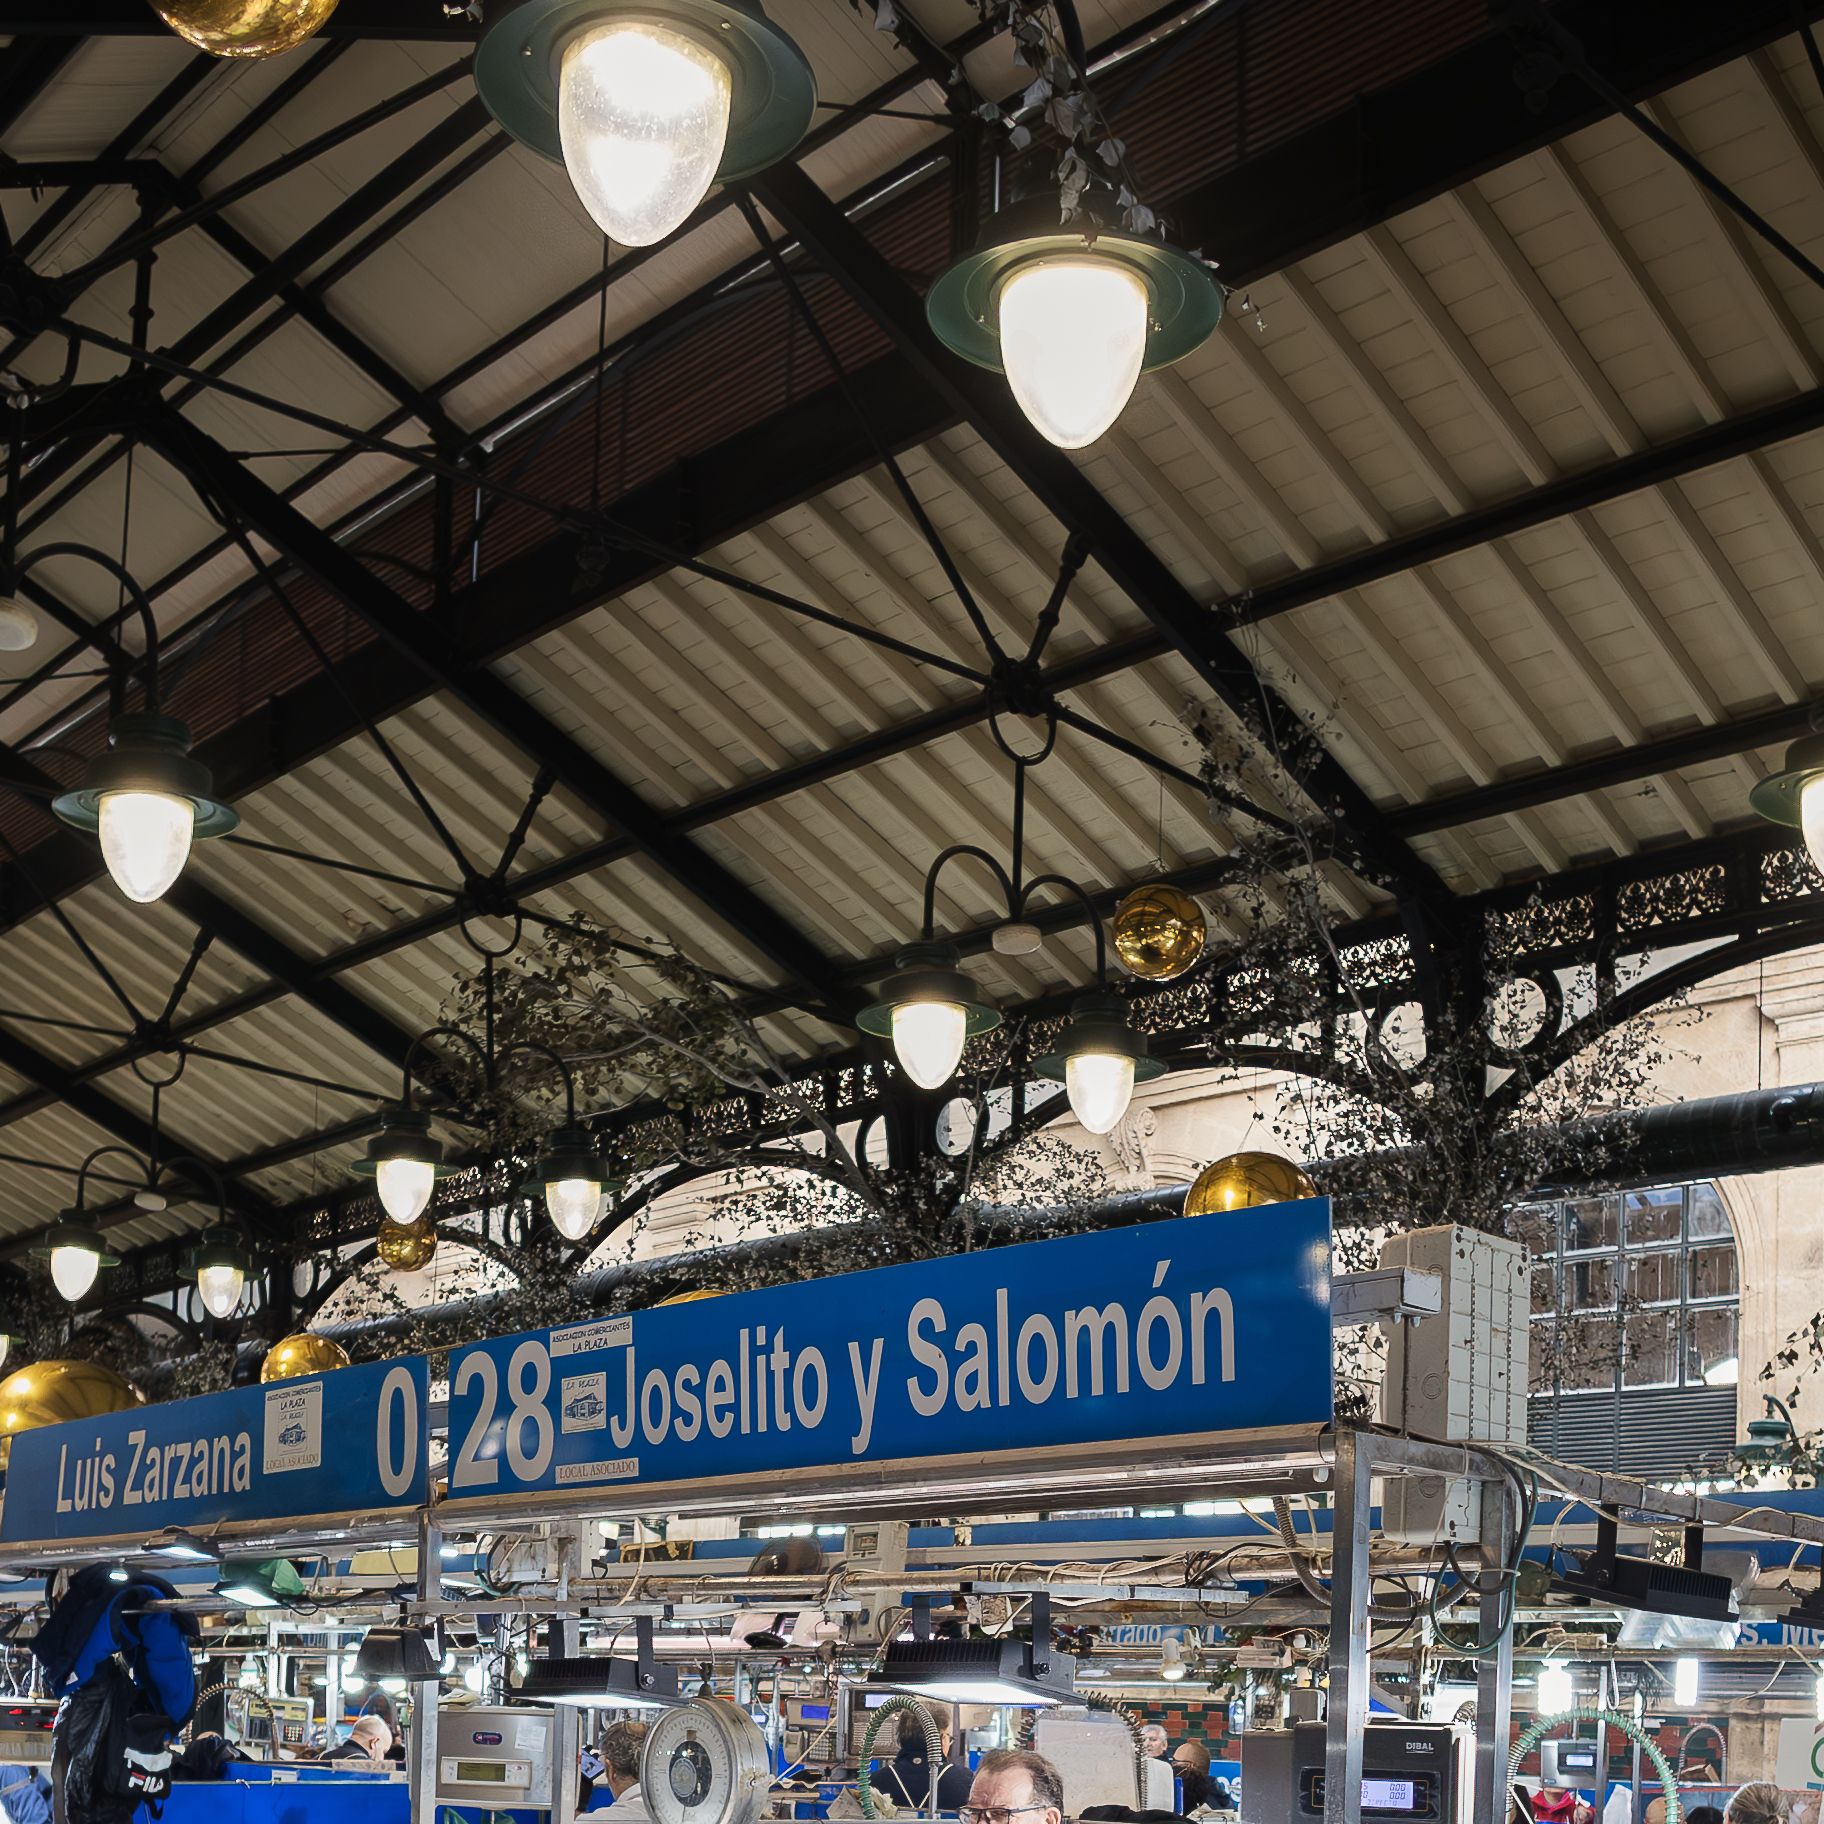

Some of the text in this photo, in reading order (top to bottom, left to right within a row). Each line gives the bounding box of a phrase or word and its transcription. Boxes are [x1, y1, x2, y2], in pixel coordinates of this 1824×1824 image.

[573, 1338, 608, 1353] LA PLAZA
[453, 1259, 1238, 1486] 28 Joselito y Salomón
[56, 1366, 418, 1513] Luis Zarzana 0
[559, 1461, 635, 1479] LOCAL ASOCIADO
[1405, 1742, 1434, 1751] DIBAL
